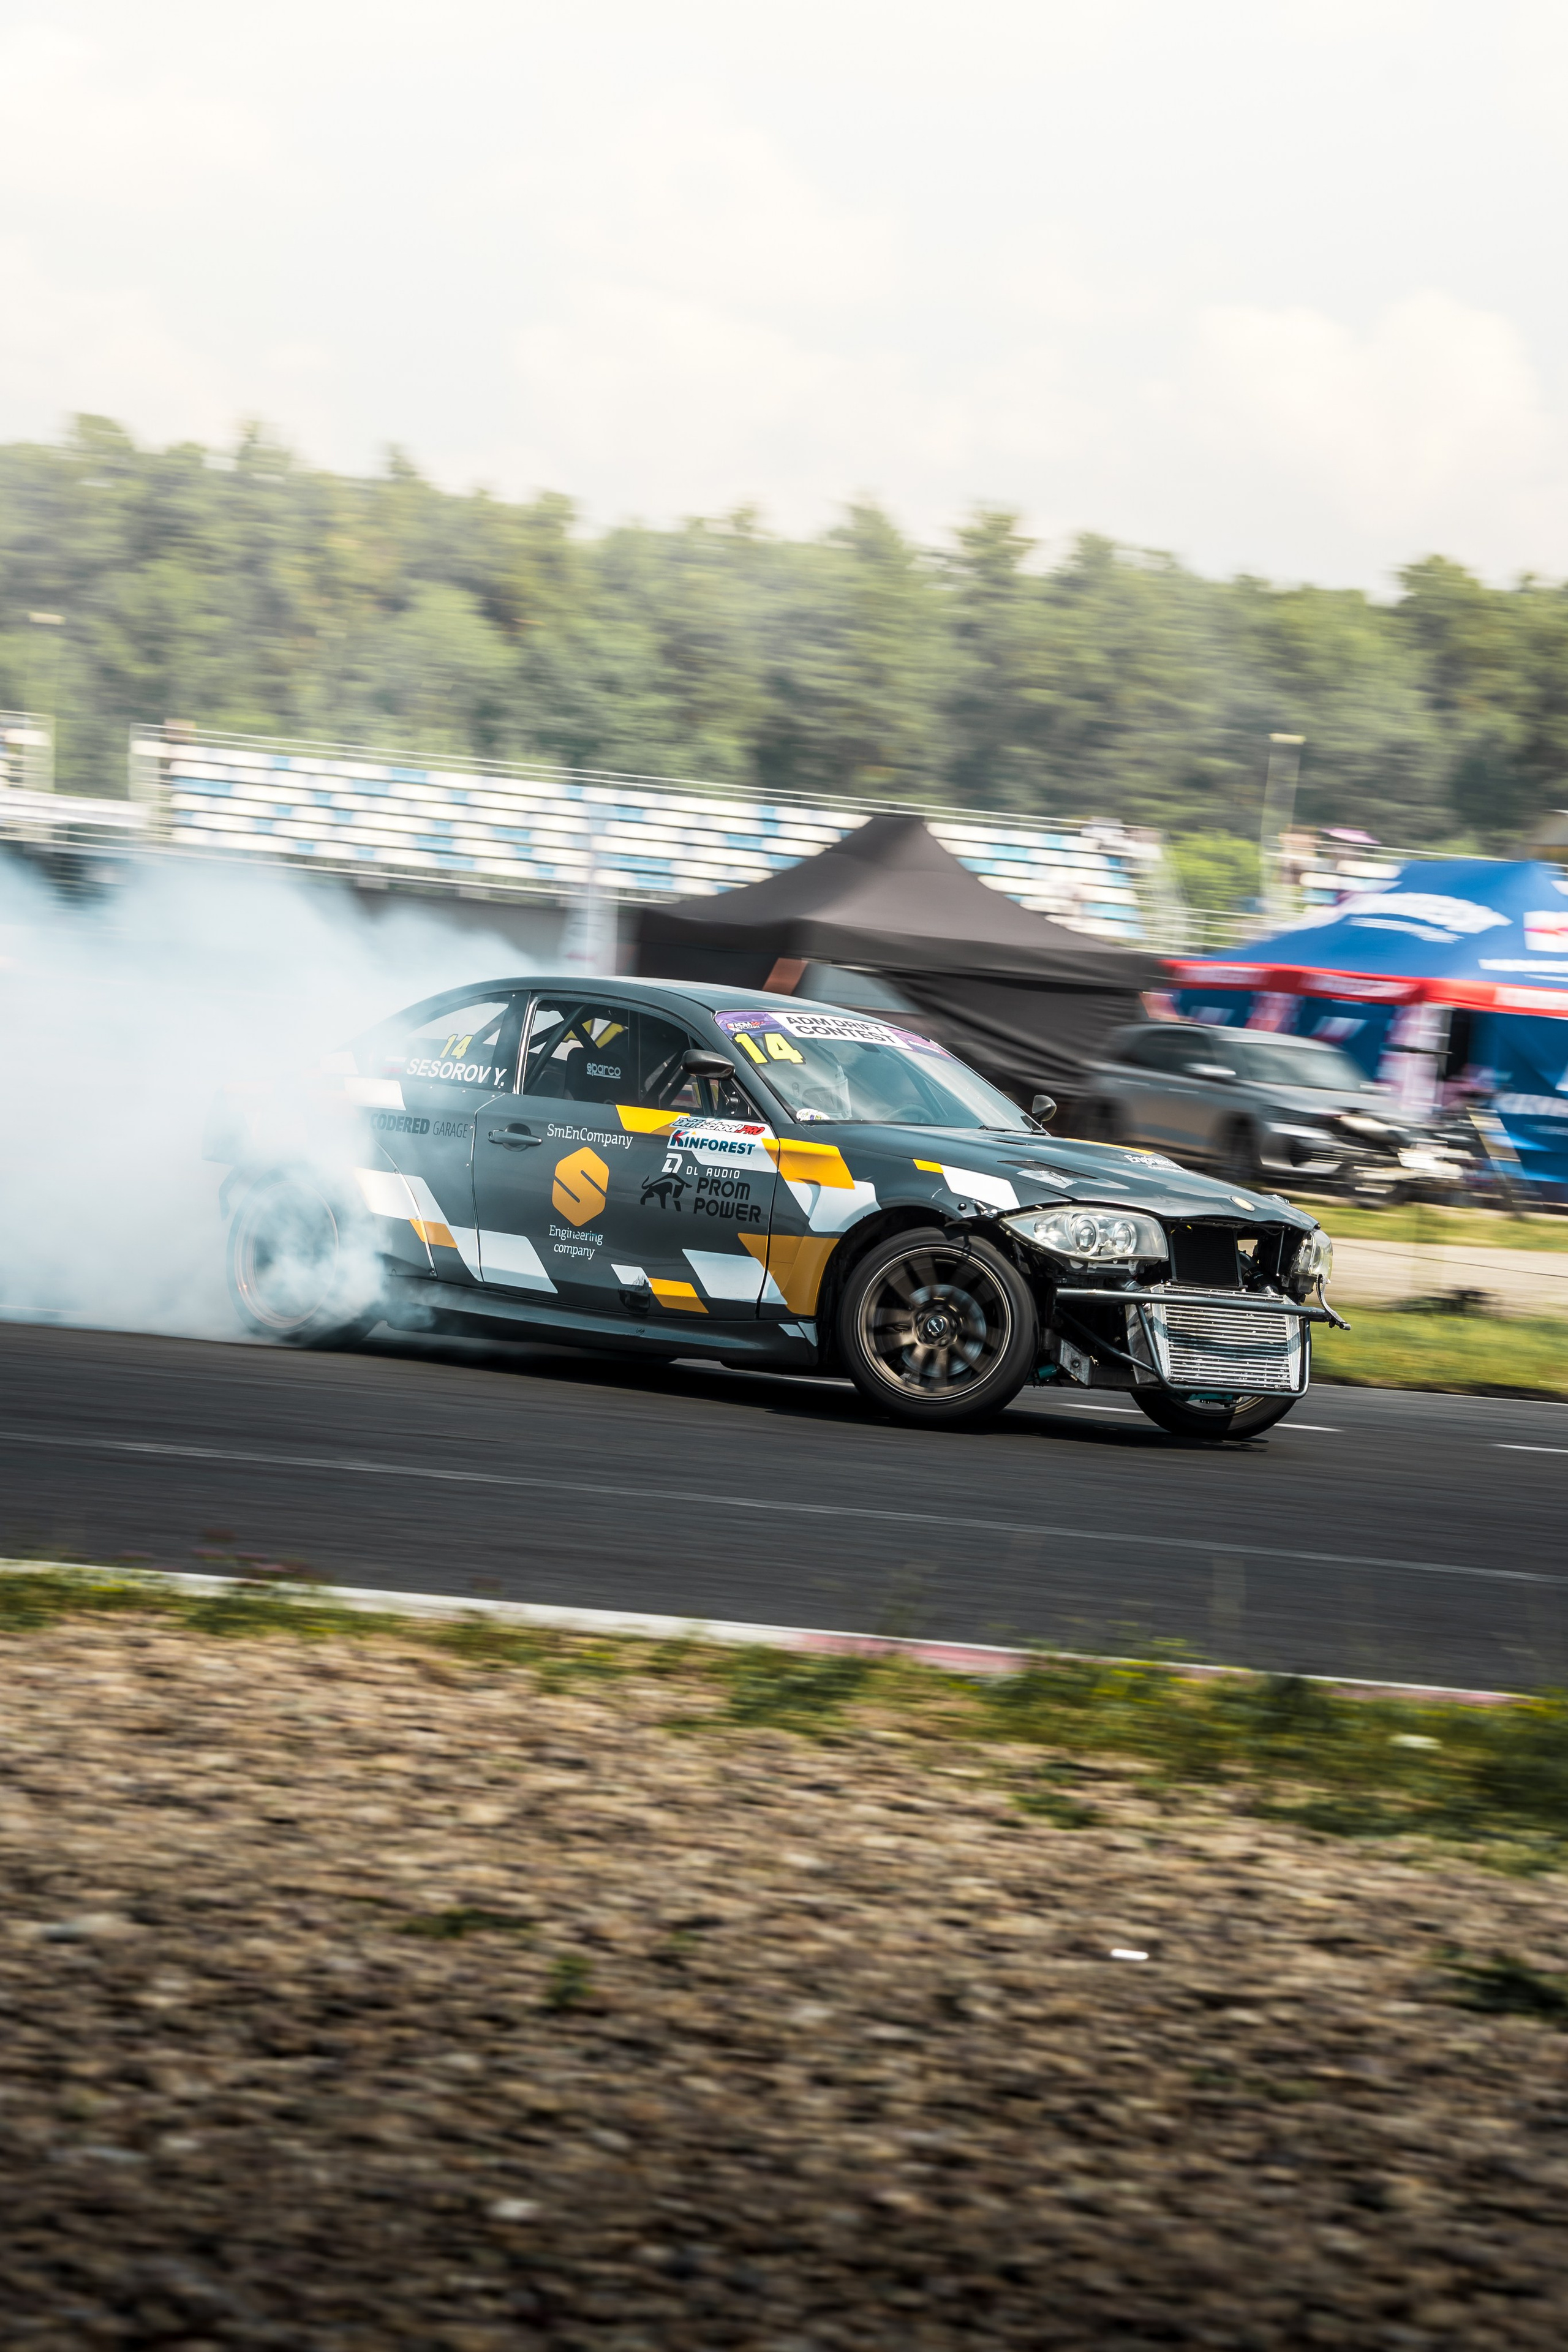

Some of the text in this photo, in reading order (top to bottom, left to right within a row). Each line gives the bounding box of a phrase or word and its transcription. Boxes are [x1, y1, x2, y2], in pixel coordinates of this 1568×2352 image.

[786, 1017, 884, 1033] ADM DRIFT
[796, 1026, 896, 1044] CONTEST
[439, 1034, 474, 1059] 14
[733, 1033, 805, 1064] 14
[406, 1058, 507, 1087] SESOROV Y.
[370, 1113, 469, 1139] CODERED GARAGE
[547, 1123, 633, 1149] SmEnCompany
[670, 1130, 756, 1155] KINFOREST
[686, 1166, 741, 1179] DL AUDIO
[696, 1177, 750, 1200] PROM
[693, 1197, 761, 1223] POWER
[549, 1225, 603, 1246] Engineering
[554, 1243, 595, 1260] company
